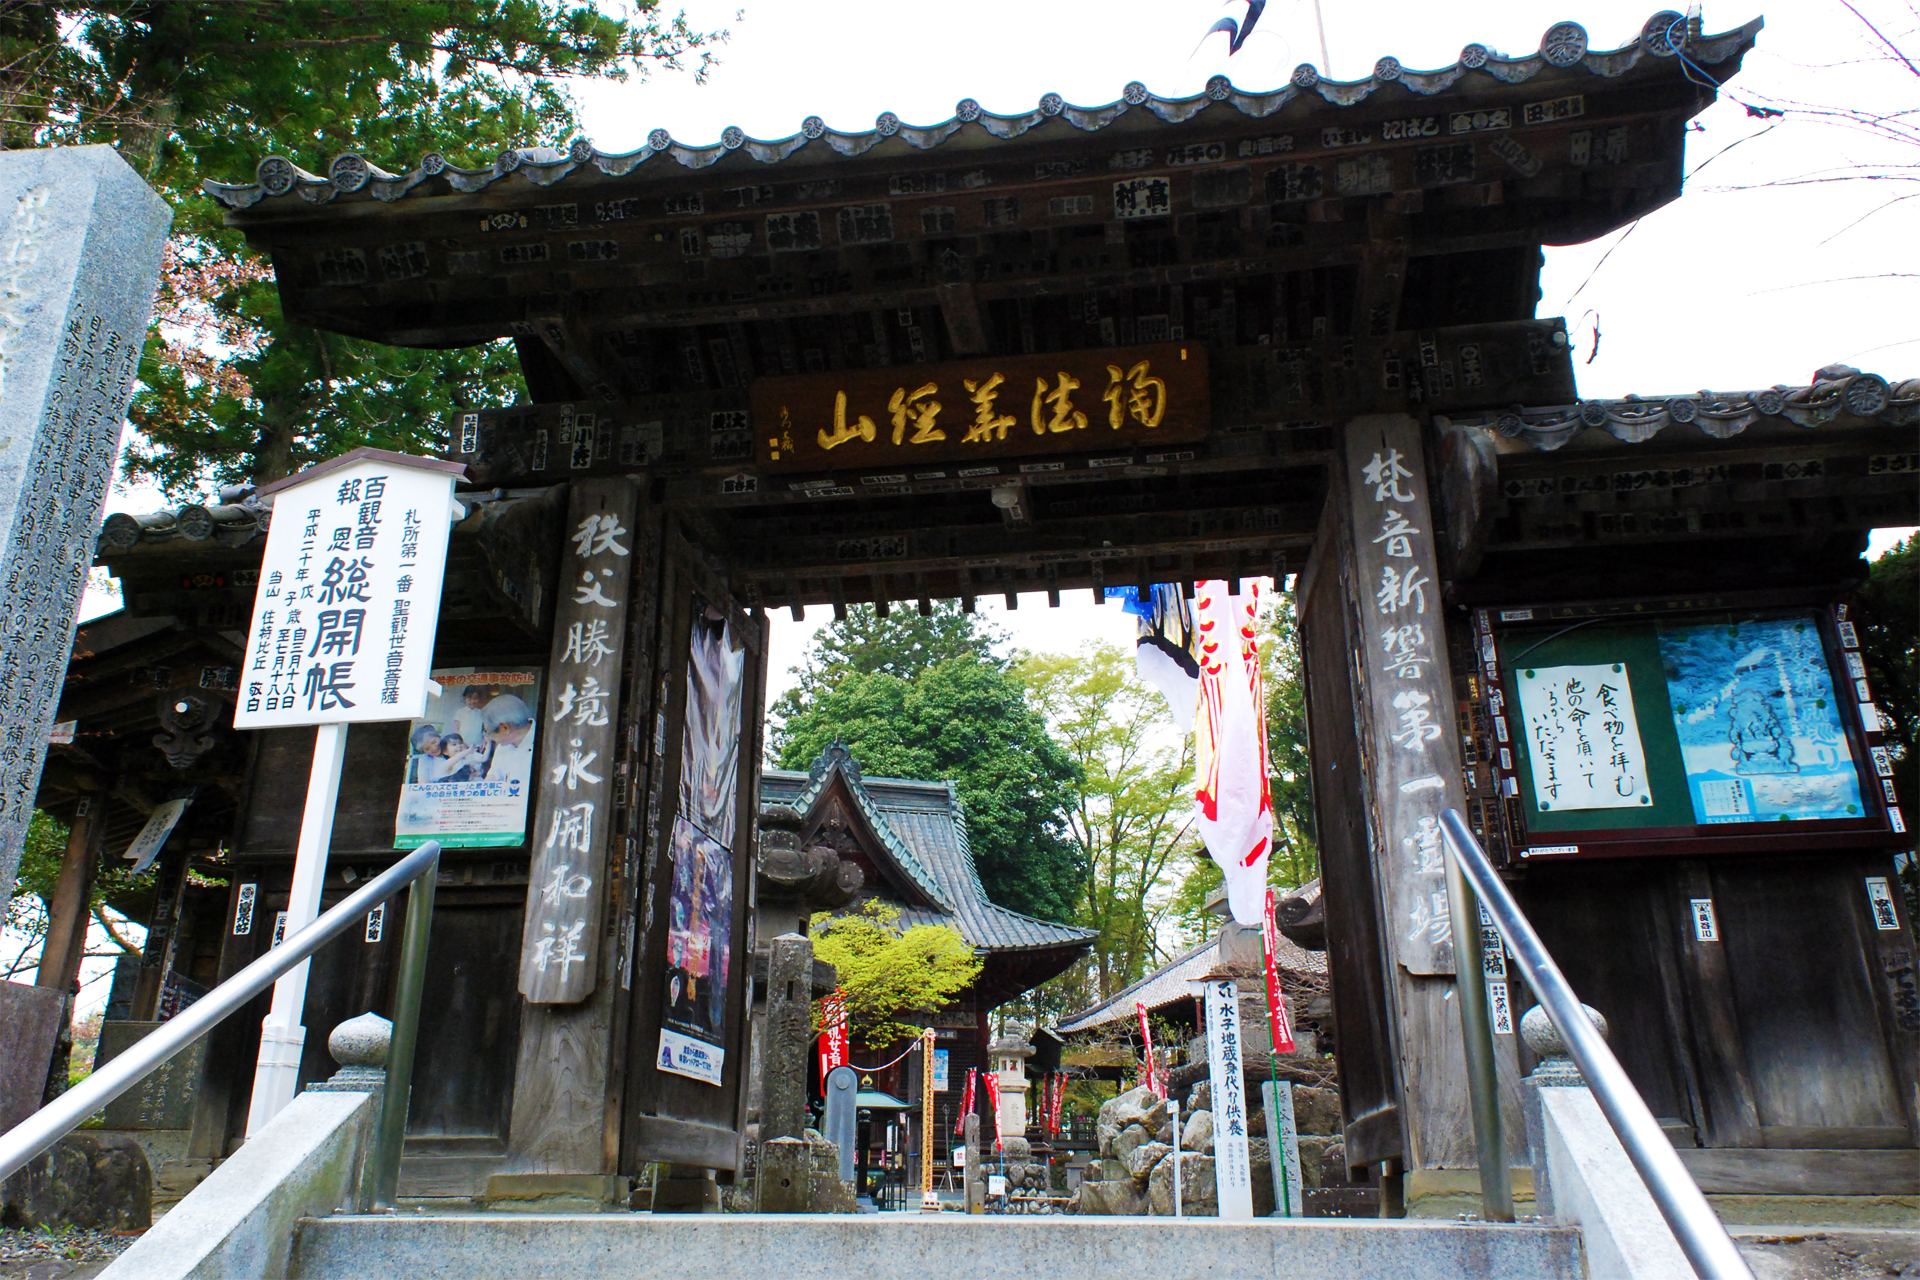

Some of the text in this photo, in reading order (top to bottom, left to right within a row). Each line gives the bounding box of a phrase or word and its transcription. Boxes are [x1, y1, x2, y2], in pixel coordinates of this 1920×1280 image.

[327, 478, 362, 552] 報恩
[355, 476, 389, 550] 百観音
[302, 556, 375, 712] 総開帳
[1565, 677, 1597, 790] 他の命を頂いて
[1596, 683, 1635, 798] 食べ物を拝む
